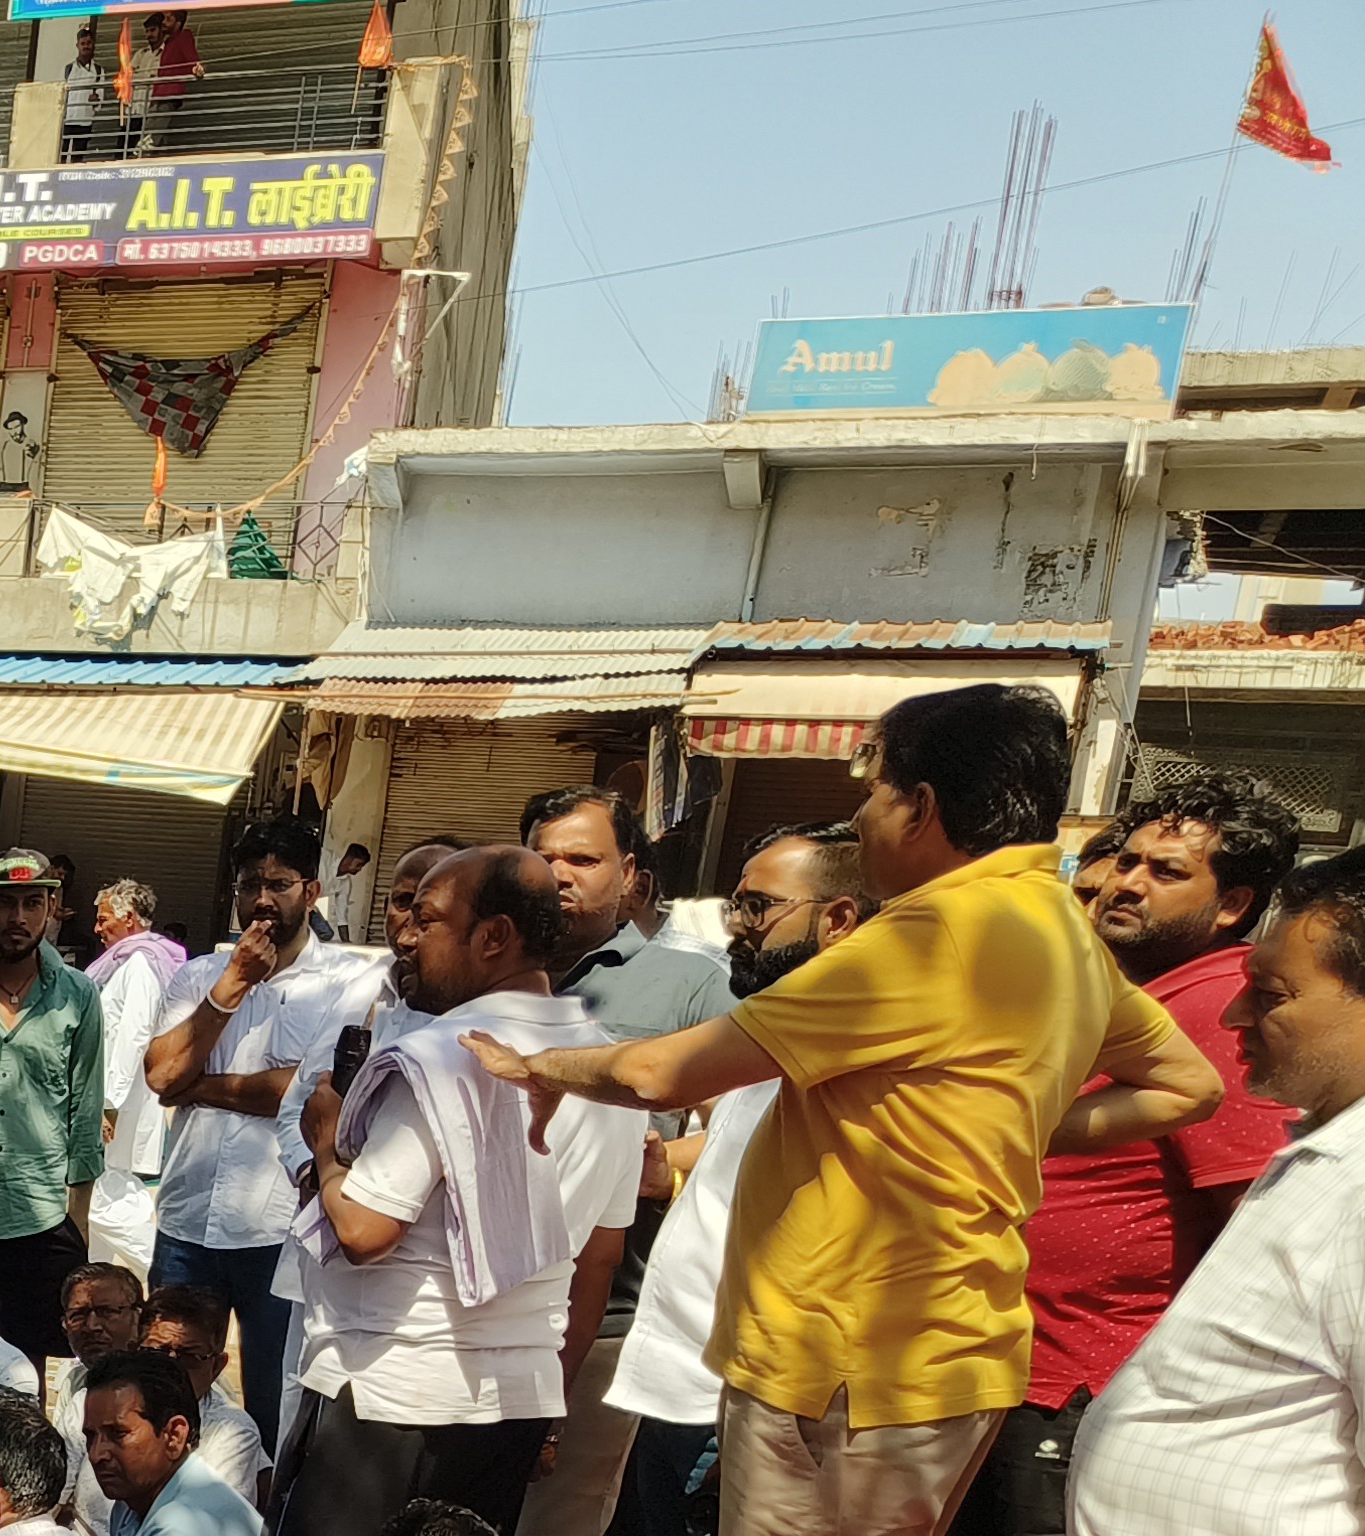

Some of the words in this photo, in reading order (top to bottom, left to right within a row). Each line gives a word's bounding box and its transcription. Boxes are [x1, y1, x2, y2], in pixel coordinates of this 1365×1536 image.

[26, 202, 117, 223] ACADEMY
[125, 177, 237, 231] A.I.T.
[23, 243, 98, 263] PGDCA
[777, 338, 895, 374] Amul
